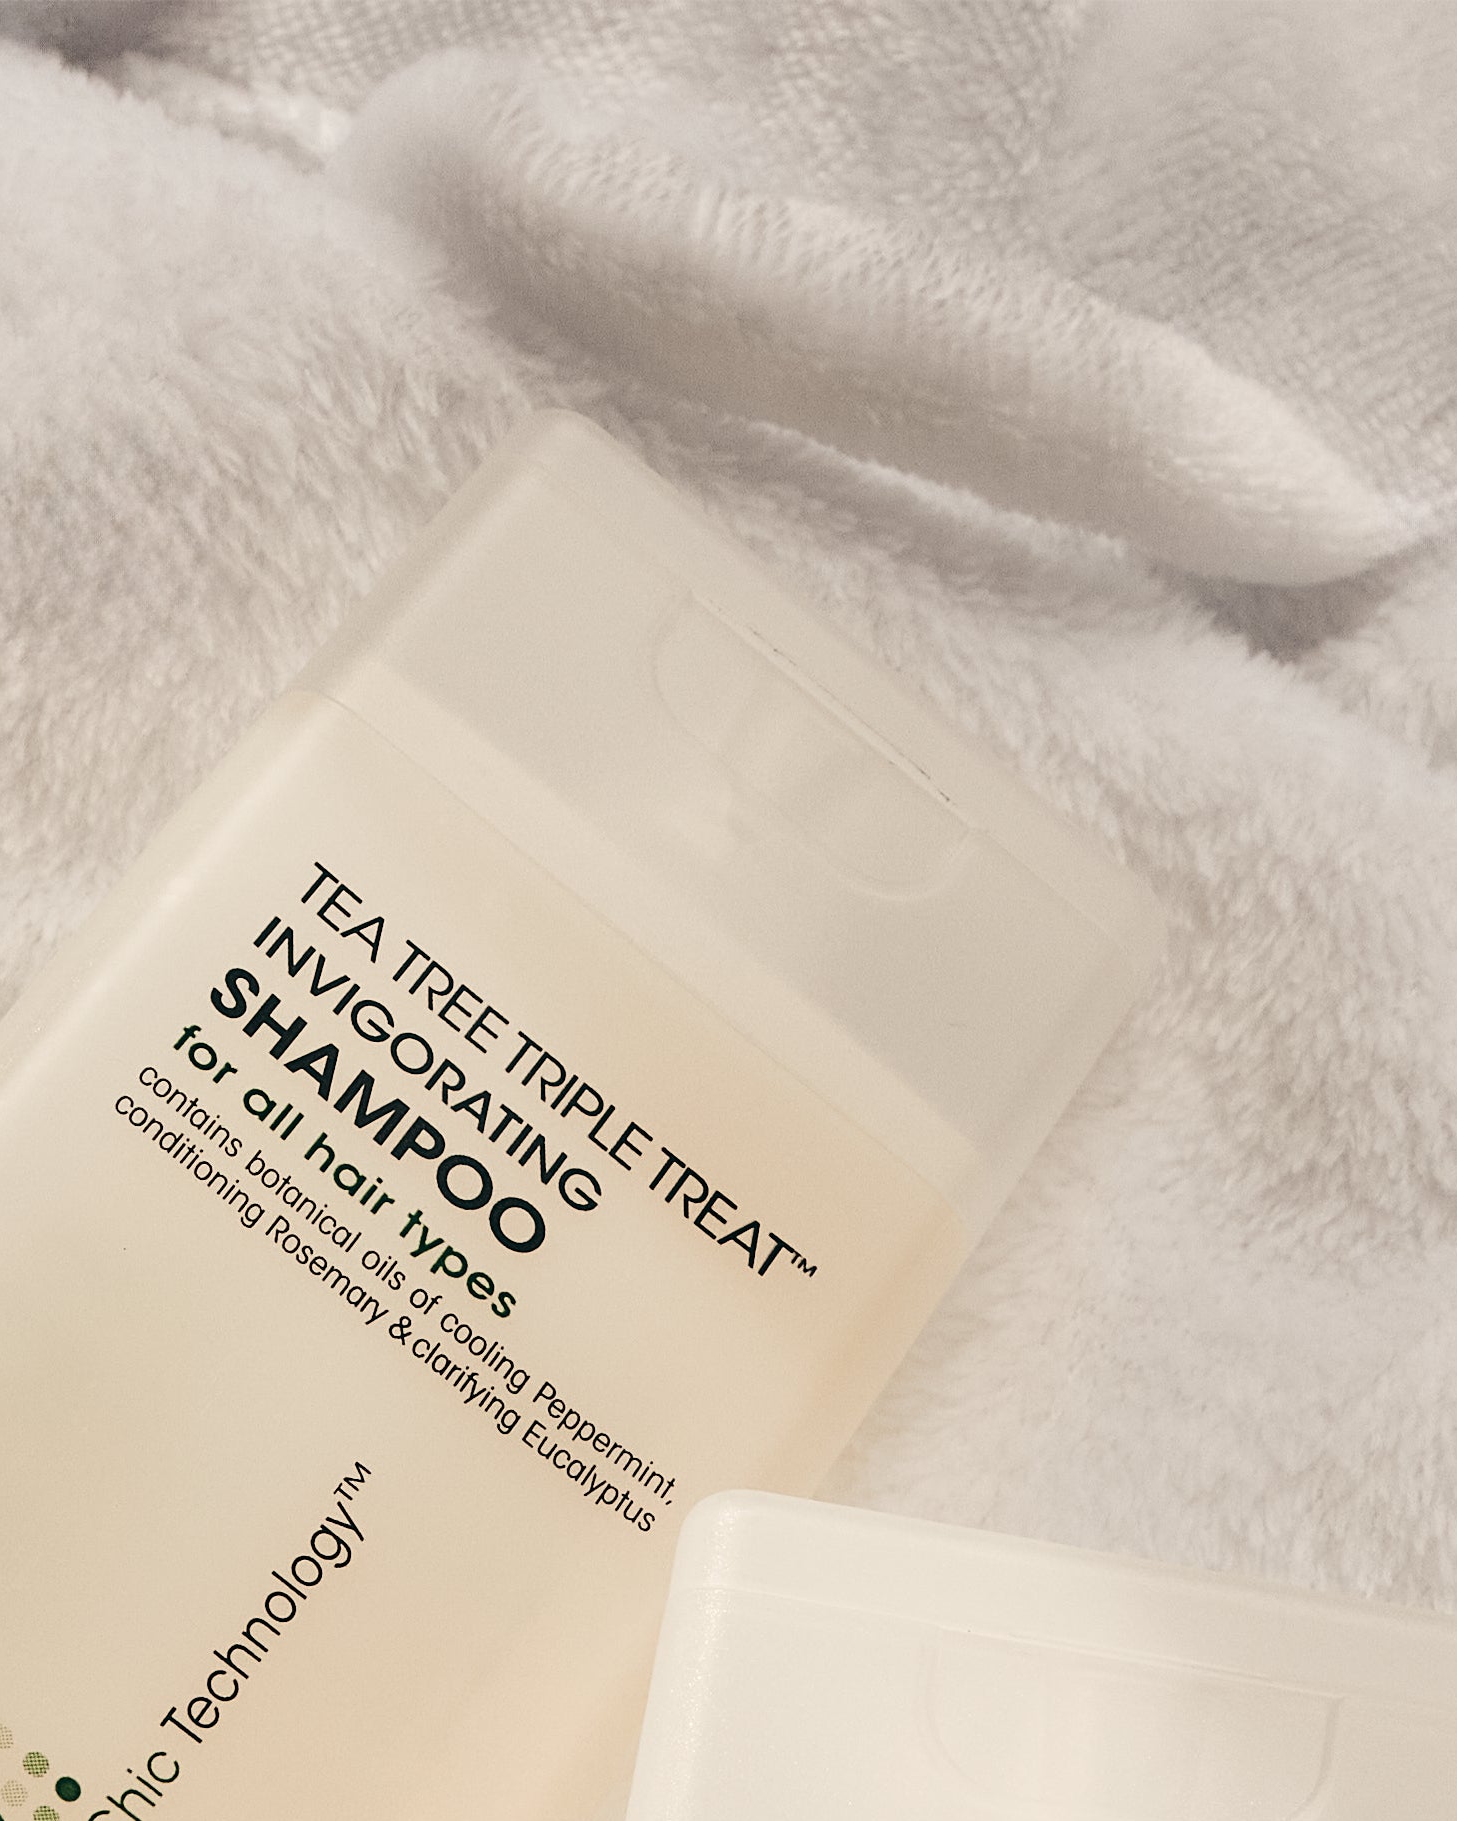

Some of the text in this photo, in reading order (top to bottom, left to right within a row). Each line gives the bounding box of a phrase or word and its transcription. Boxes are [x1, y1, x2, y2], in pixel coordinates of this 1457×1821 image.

[209, 967, 547, 1254] SHAMPOO
[252, 915, 603, 1213] INVIGORATING
[300, 861, 386, 965] TEA
[391, 938, 511, 1055] TREE
[504, 1029, 654, 1172] TRIPLE
[114, 1095, 656, 1533] conditioning Rosemary & clarifying Eucalyptus
[138, 1066, 676, 1507] contains botanical oils of cooling Peppermint,
[172, 1024, 517, 1319] for all hair types
